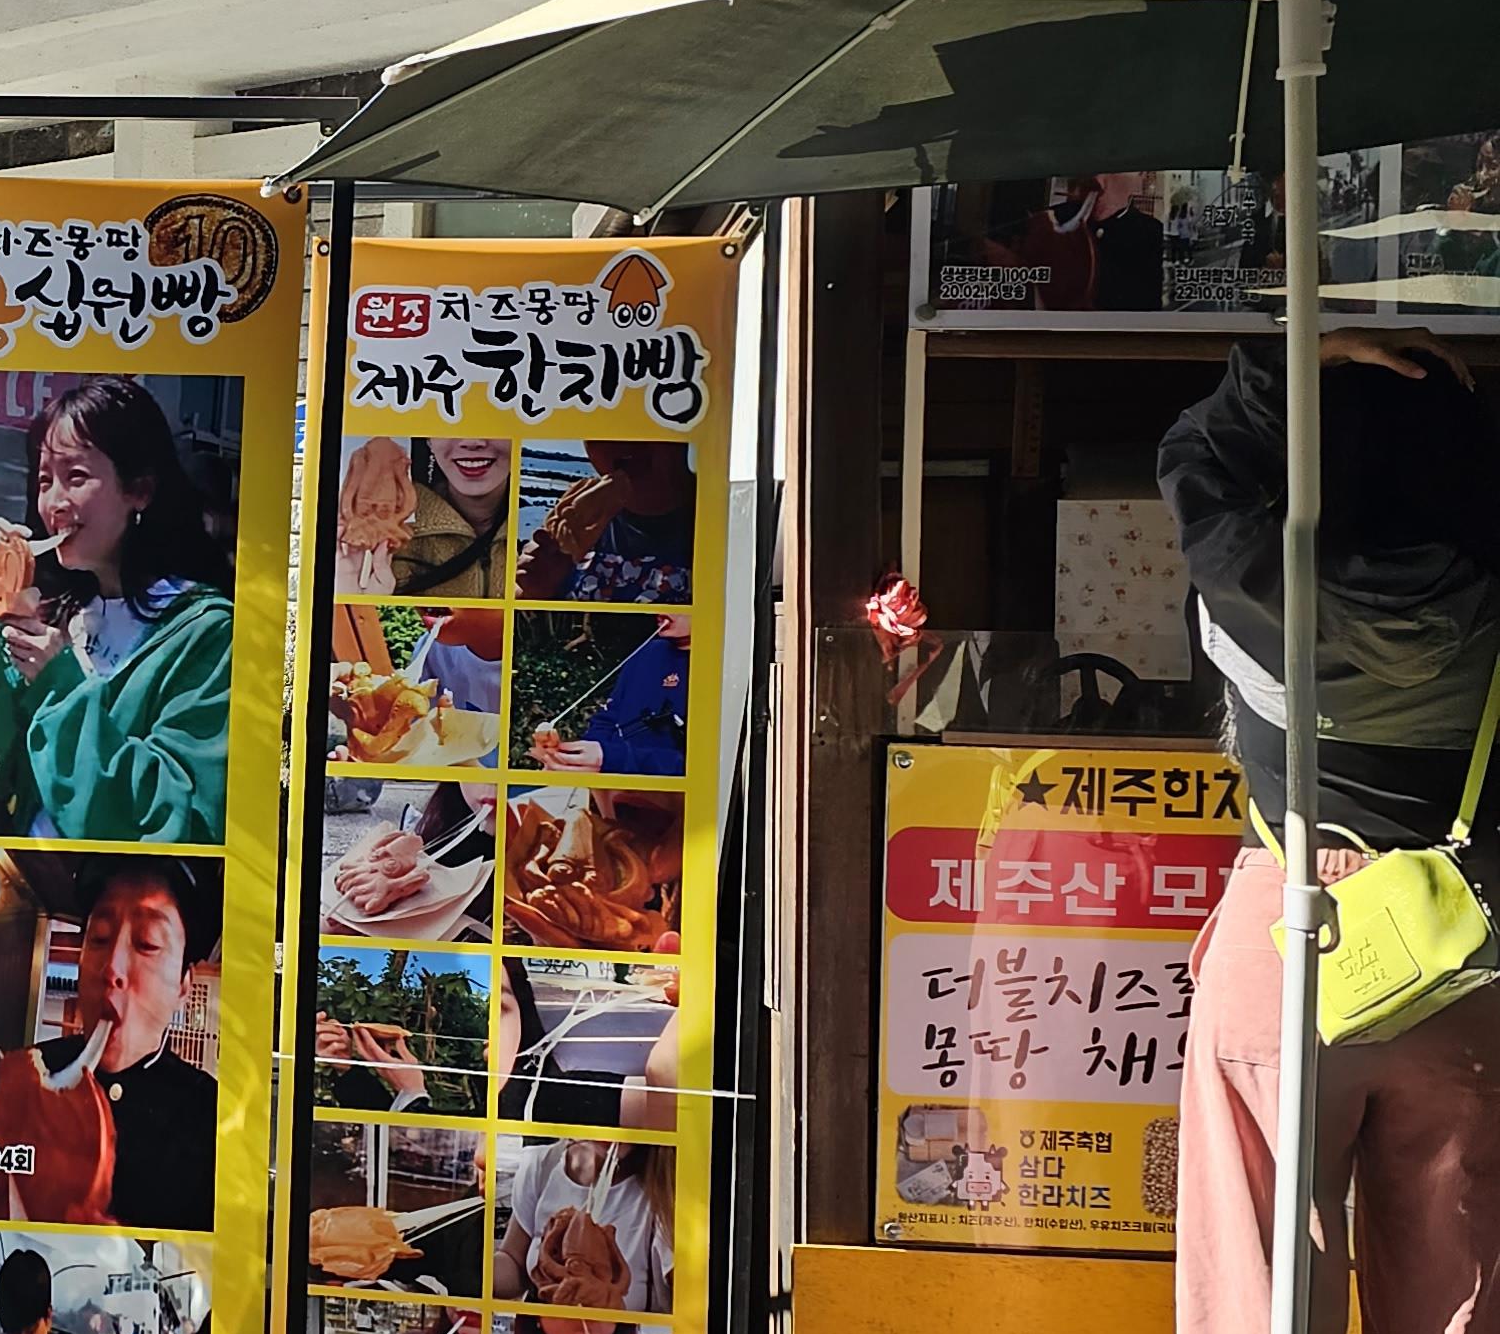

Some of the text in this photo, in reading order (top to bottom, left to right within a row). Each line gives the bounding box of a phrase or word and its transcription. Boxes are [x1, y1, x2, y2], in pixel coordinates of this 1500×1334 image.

[1261, 270, 1286, 285] 219
[362, 296, 430, 333] 원조
[356, 328, 704, 424] 제주 한치빵
[930, 860, 1235, 917] 제주산 모
[922, 1024, 1049, 1090] 몽땅
[1018, 1156, 1066, 1179] 삼다
[1018, 1184, 1112, 1210] 한라치즈
